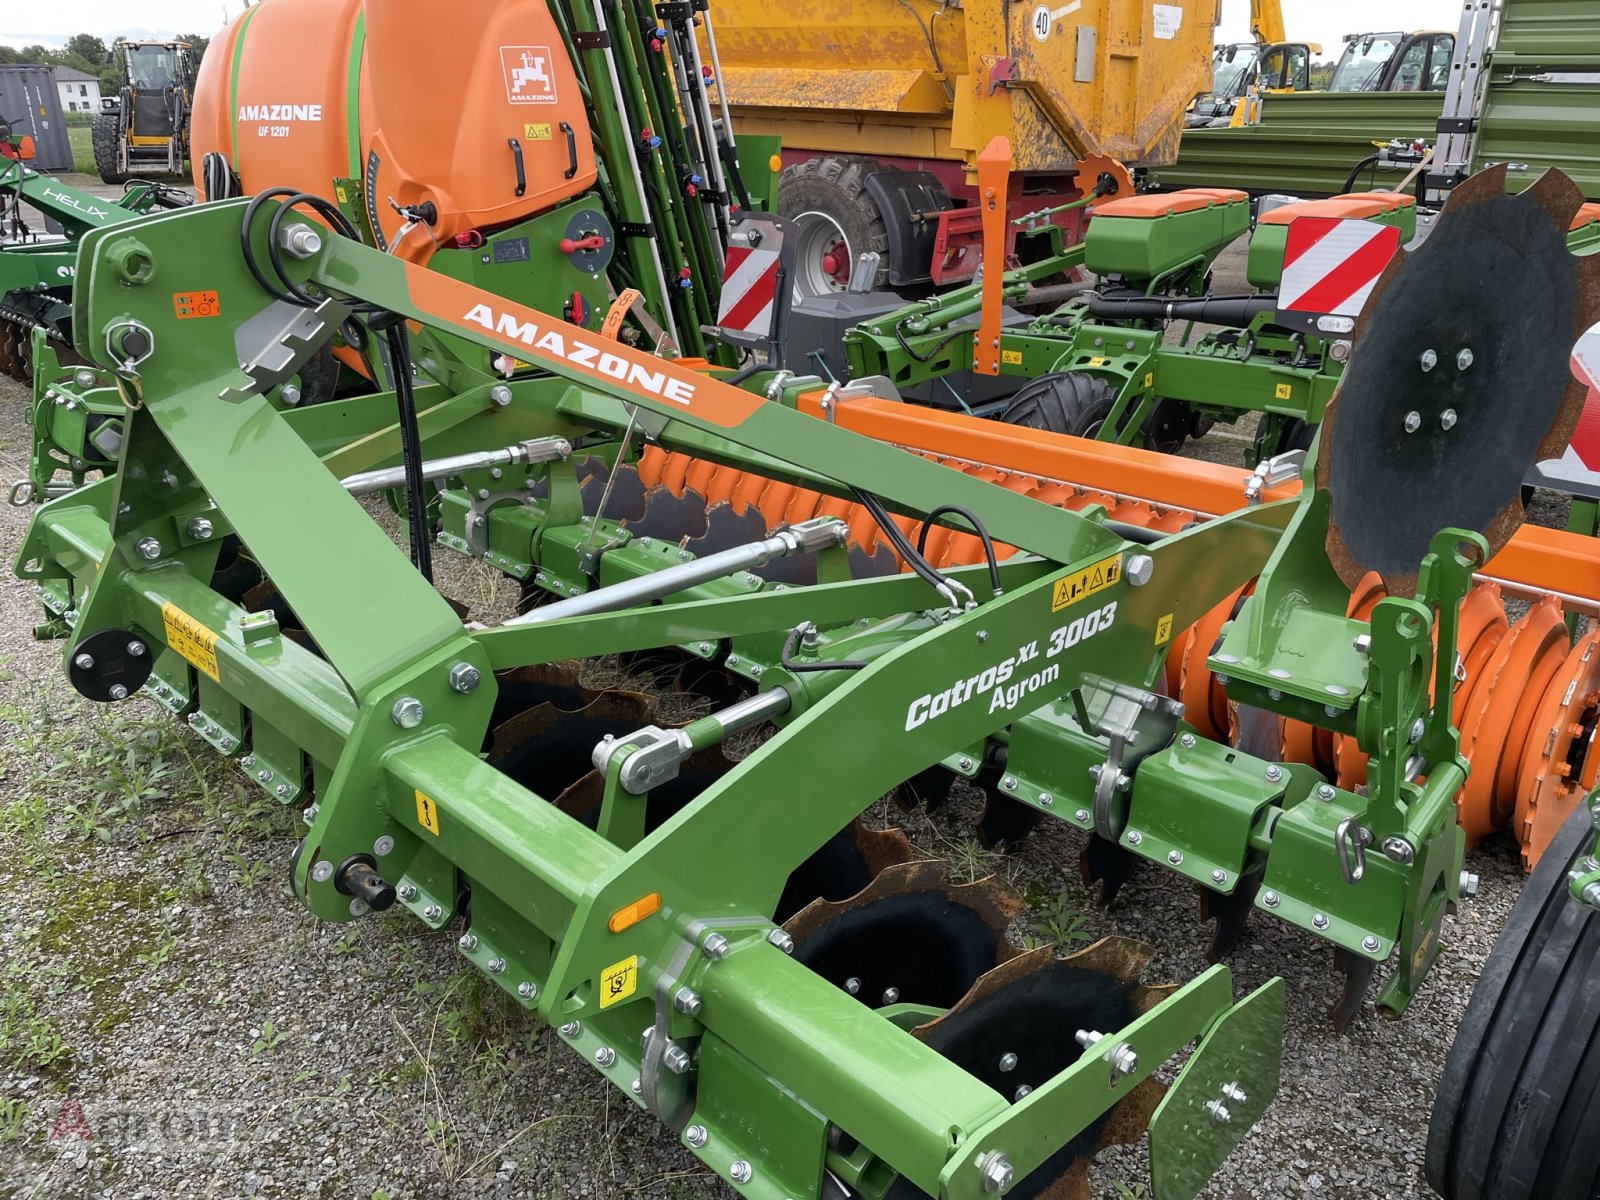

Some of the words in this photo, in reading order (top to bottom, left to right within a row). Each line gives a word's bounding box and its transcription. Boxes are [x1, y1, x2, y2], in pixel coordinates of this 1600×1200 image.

[1036, 12, 1048, 35] 40
[238, 104, 322, 121] AMAZONE
[258, 126, 269, 137] UF
[270, 126, 290, 137] 1201
[43, 187, 109, 220] HELIX
[463, 303, 696, 406] AMAZONE
[1046, 600, 1118, 658] 3003
[988, 663, 1060, 715] Agrom
